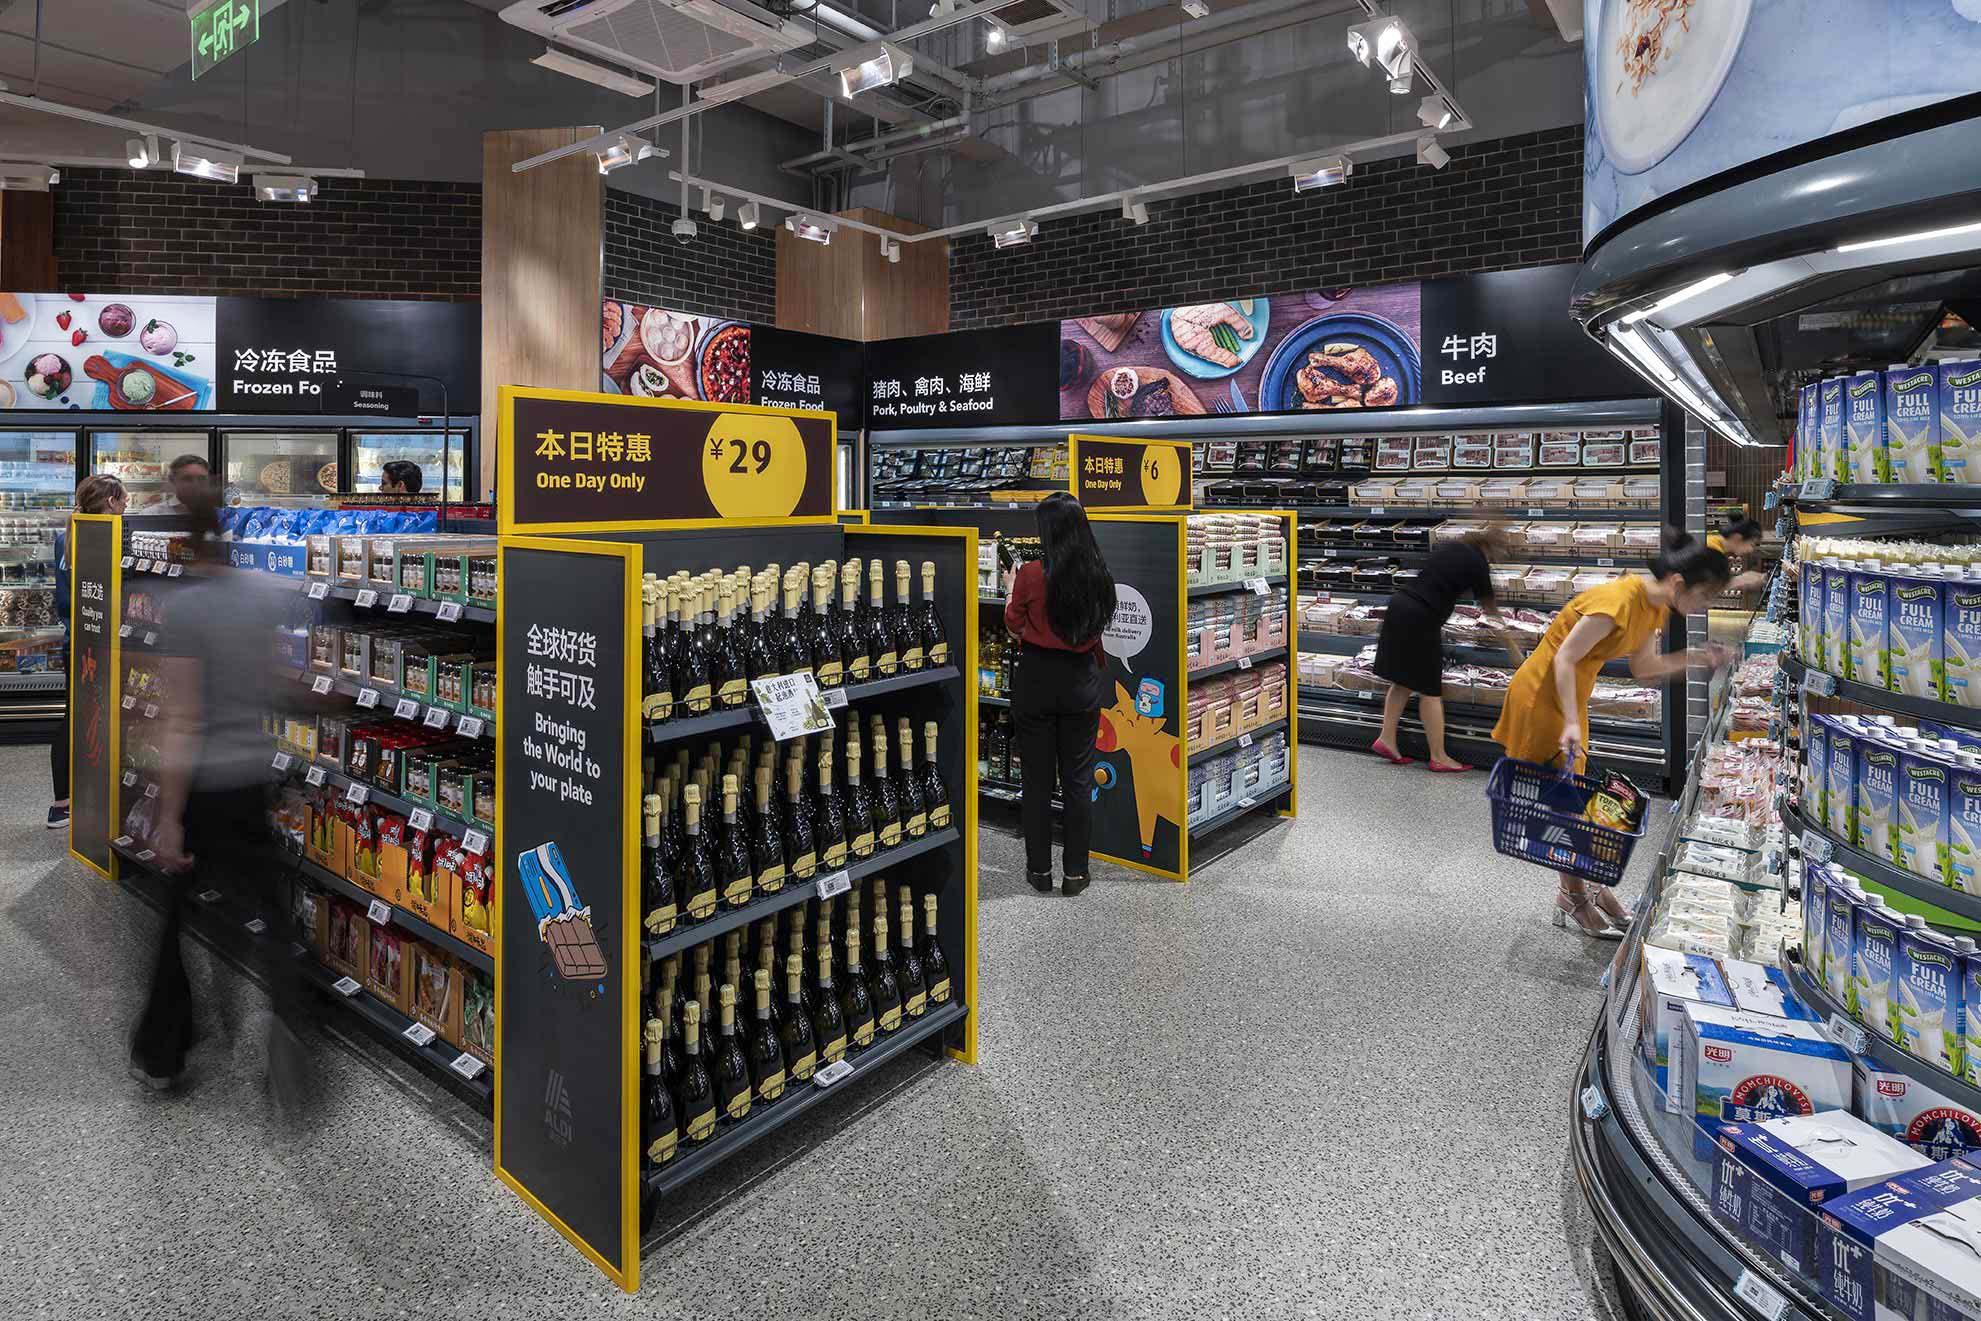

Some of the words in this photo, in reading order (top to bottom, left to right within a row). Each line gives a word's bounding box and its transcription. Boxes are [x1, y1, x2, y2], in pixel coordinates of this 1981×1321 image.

[1441, 332, 1497, 361] 牛肉
[234, 349, 337, 374] 冷冻食品
[761, 370, 821, 395] 冷冻食品
[1441, 366, 1486, 385] Beef
[1898, 376, 1929, 391] WESTACRE
[233, 380, 293, 395] Frozen
[873, 372, 991, 399] 猪肉、禽肉、海鲜
[353, 401, 389, 410] Seasoning
[761, 396, 796, 410] Frozen
[799, 400, 824, 412] Food
[873, 405, 898, 417] Pork,
[900, 402, 935, 415] Poultry
[938, 401, 947, 412] &
[949, 397, 993, 412] Seafood
[1853, 399, 1875, 414] FULL
[1897, 393, 1929, 408] FULL
[1853, 411, 1875, 422] CREAM
[1897, 406, 1930, 417] CREAM
[535, 429, 651, 463] 本日特惠
[710, 438, 772, 475] ¥29
[1084, 456, 1123, 474] 本日特惠
[536, 472, 571, 489] One
[576, 473, 606, 493] Day
[611, 473, 646, 493] Only
[1085, 480, 1097, 489] One
[1097, 480, 1108, 491] Day
[1109, 480, 1122, 491] Only
[1903, 588, 1931, 598] WESTACRE
[1860, 597, 1882, 611] FULL
[1901, 603, 1933, 618] FULL
[1858, 609, 1882, 620] CREAM
[1900, 616, 1933, 628] CREAM
[527, 623, 596, 667] 全球好货
[527, 662, 596, 711] 触手可及
[535, 712, 586, 750] Bringing
[523, 736, 542, 759] the
[545, 742, 582, 774] World
[586, 757, 601, 779] to
[1868, 765, 1892, 784] FULL
[1911, 769, 1940, 777] WESTACRE
[530, 769, 557, 793] your
[561, 777, 593, 806] plate
[1867, 778, 1893, 793] CREAM
[1909, 780, 1940, 800] FULL
[1909, 792, 1940, 810] CREAM
[1866, 936, 1891, 960] FULL
[1865, 948, 1891, 969] CREAM
[1913, 952, 1945, 963] WESTACRE
[1912, 962, 1946, 988] FULL
[1910, 975, 1946, 998] CREAM
[1706, 1046, 1731, 1058] 光明
[1736, 1077, 1811, 1113] MOMCHILOVTSI
[1879, 1081, 1904, 1093] 光明
[1735, 1106, 1784, 1120] 莫斯
